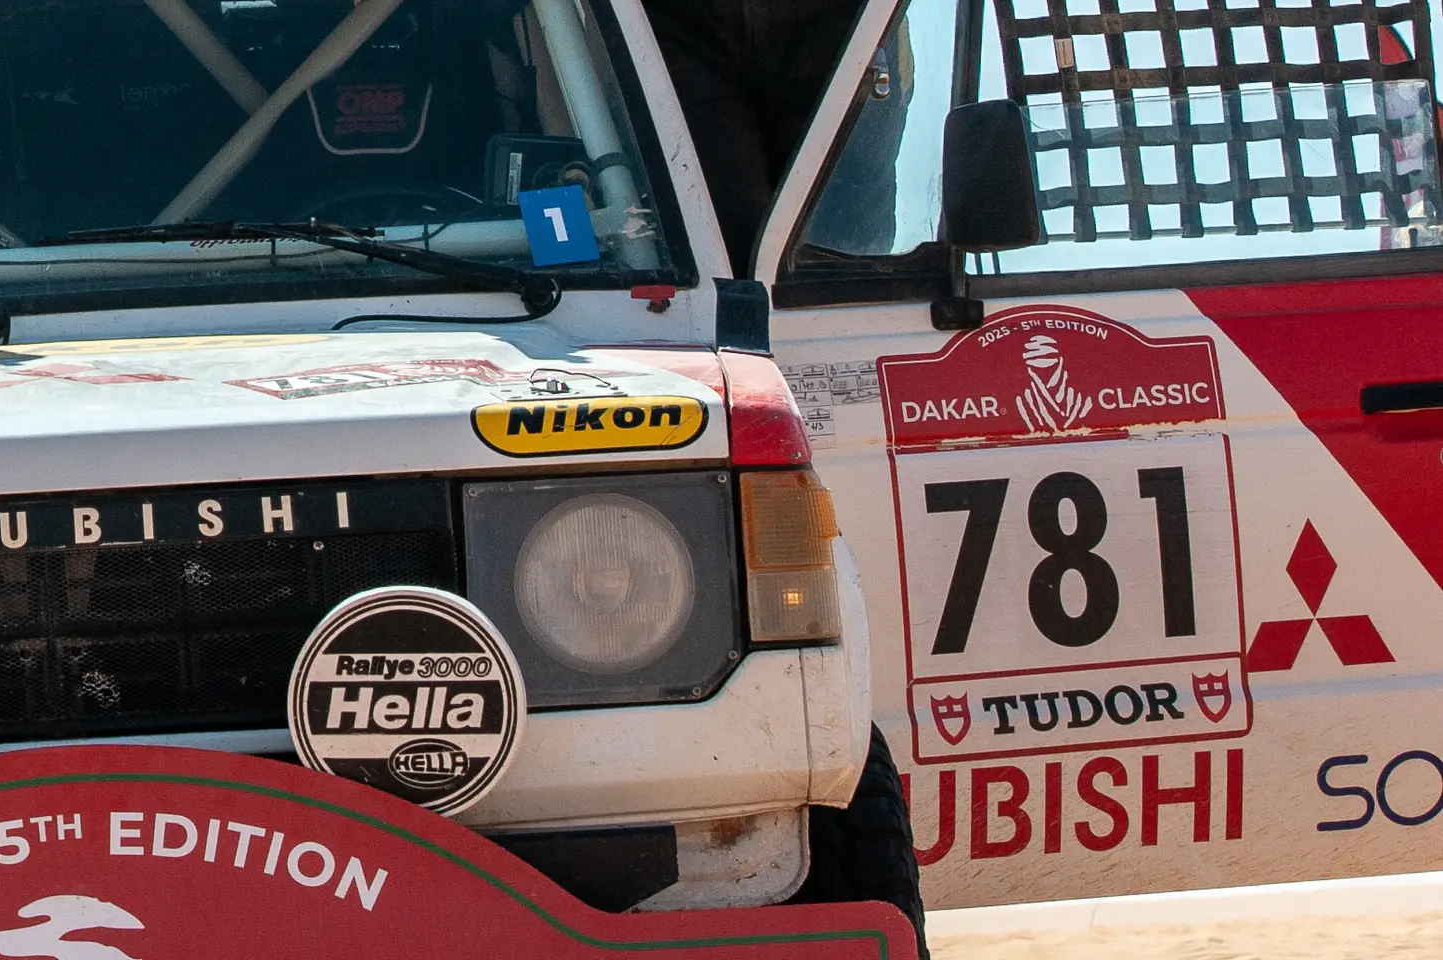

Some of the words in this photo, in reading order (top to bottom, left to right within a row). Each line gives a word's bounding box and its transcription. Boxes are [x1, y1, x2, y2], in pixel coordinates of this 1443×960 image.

[544, 207, 568, 242] 1
[977, 325, 1011, 348] 2025
[1021, 320, 1041, 331] 5TH
[1045, 319, 1108, 340] EDITION
[506, 402, 682, 436] Nikon
[901, 396, 1000, 423] DAKAR
[1098, 382, 1210, 410] CLASSIC
[924, 466, 1198, 654] 781
[336, 656, 414, 680] Rallye
[416, 656, 493, 678] 3000
[325, 686, 485, 729] Hella
[982, 682, 1184, 735] TUDOR
[394, 751, 468, 774] HELLA
[108, 811, 390, 912] EDITION
